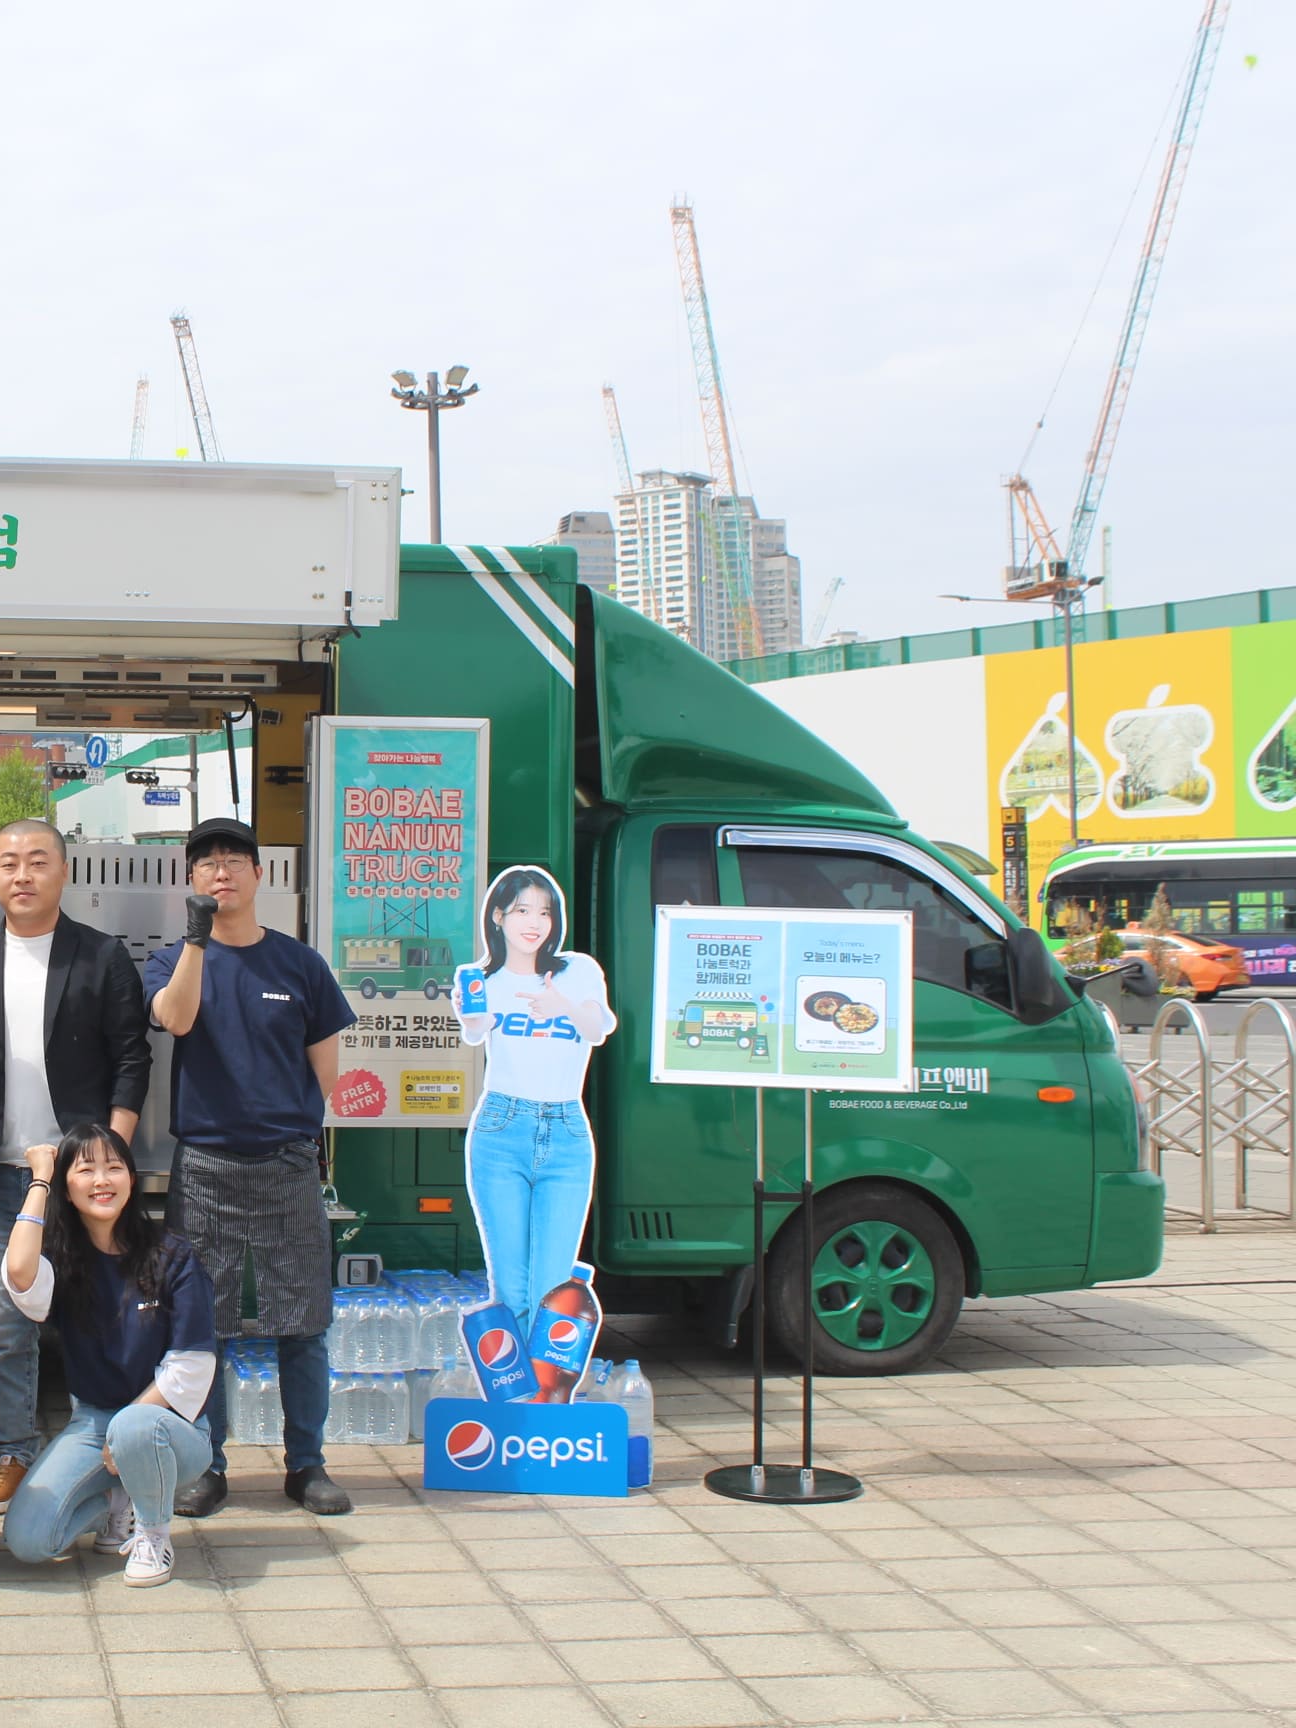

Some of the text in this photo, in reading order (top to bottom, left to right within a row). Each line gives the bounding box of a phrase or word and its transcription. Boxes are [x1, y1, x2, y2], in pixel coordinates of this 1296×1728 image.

[344, 787, 464, 819] BOBAE
[344, 823, 462, 852] NANUM
[345, 854, 459, 883] TRUCK
[697, 943, 752, 957] BOBAE
[803, 951, 881, 965] 오늘의 메뉴는?
[696, 958, 752, 970] 나눔트럭과
[696, 971, 752, 985] 함께해요!
[346, 1014, 461, 1032] 뜻하고 맛있는
[395, 1035, 461, 1049] 제공합니다
[702, 1028, 736, 1038] BOBAE
[913, 1066, 989, 1094] 프앤비
[341, 1081, 372, 1102] FREE
[340, 1091, 381, 1116] ENTRY
[829, 1100, 859, 1110] BOBAE
[860, 1100, 883, 1110] FOOD
[885, 1100, 892, 1110] &
[893, 1100, 937, 1110] BEVERAGE
[544, 1349, 571, 1364] pepsi
[491, 1367, 526, 1390] pepsi
[501, 1432, 603, 1468] pepsi
